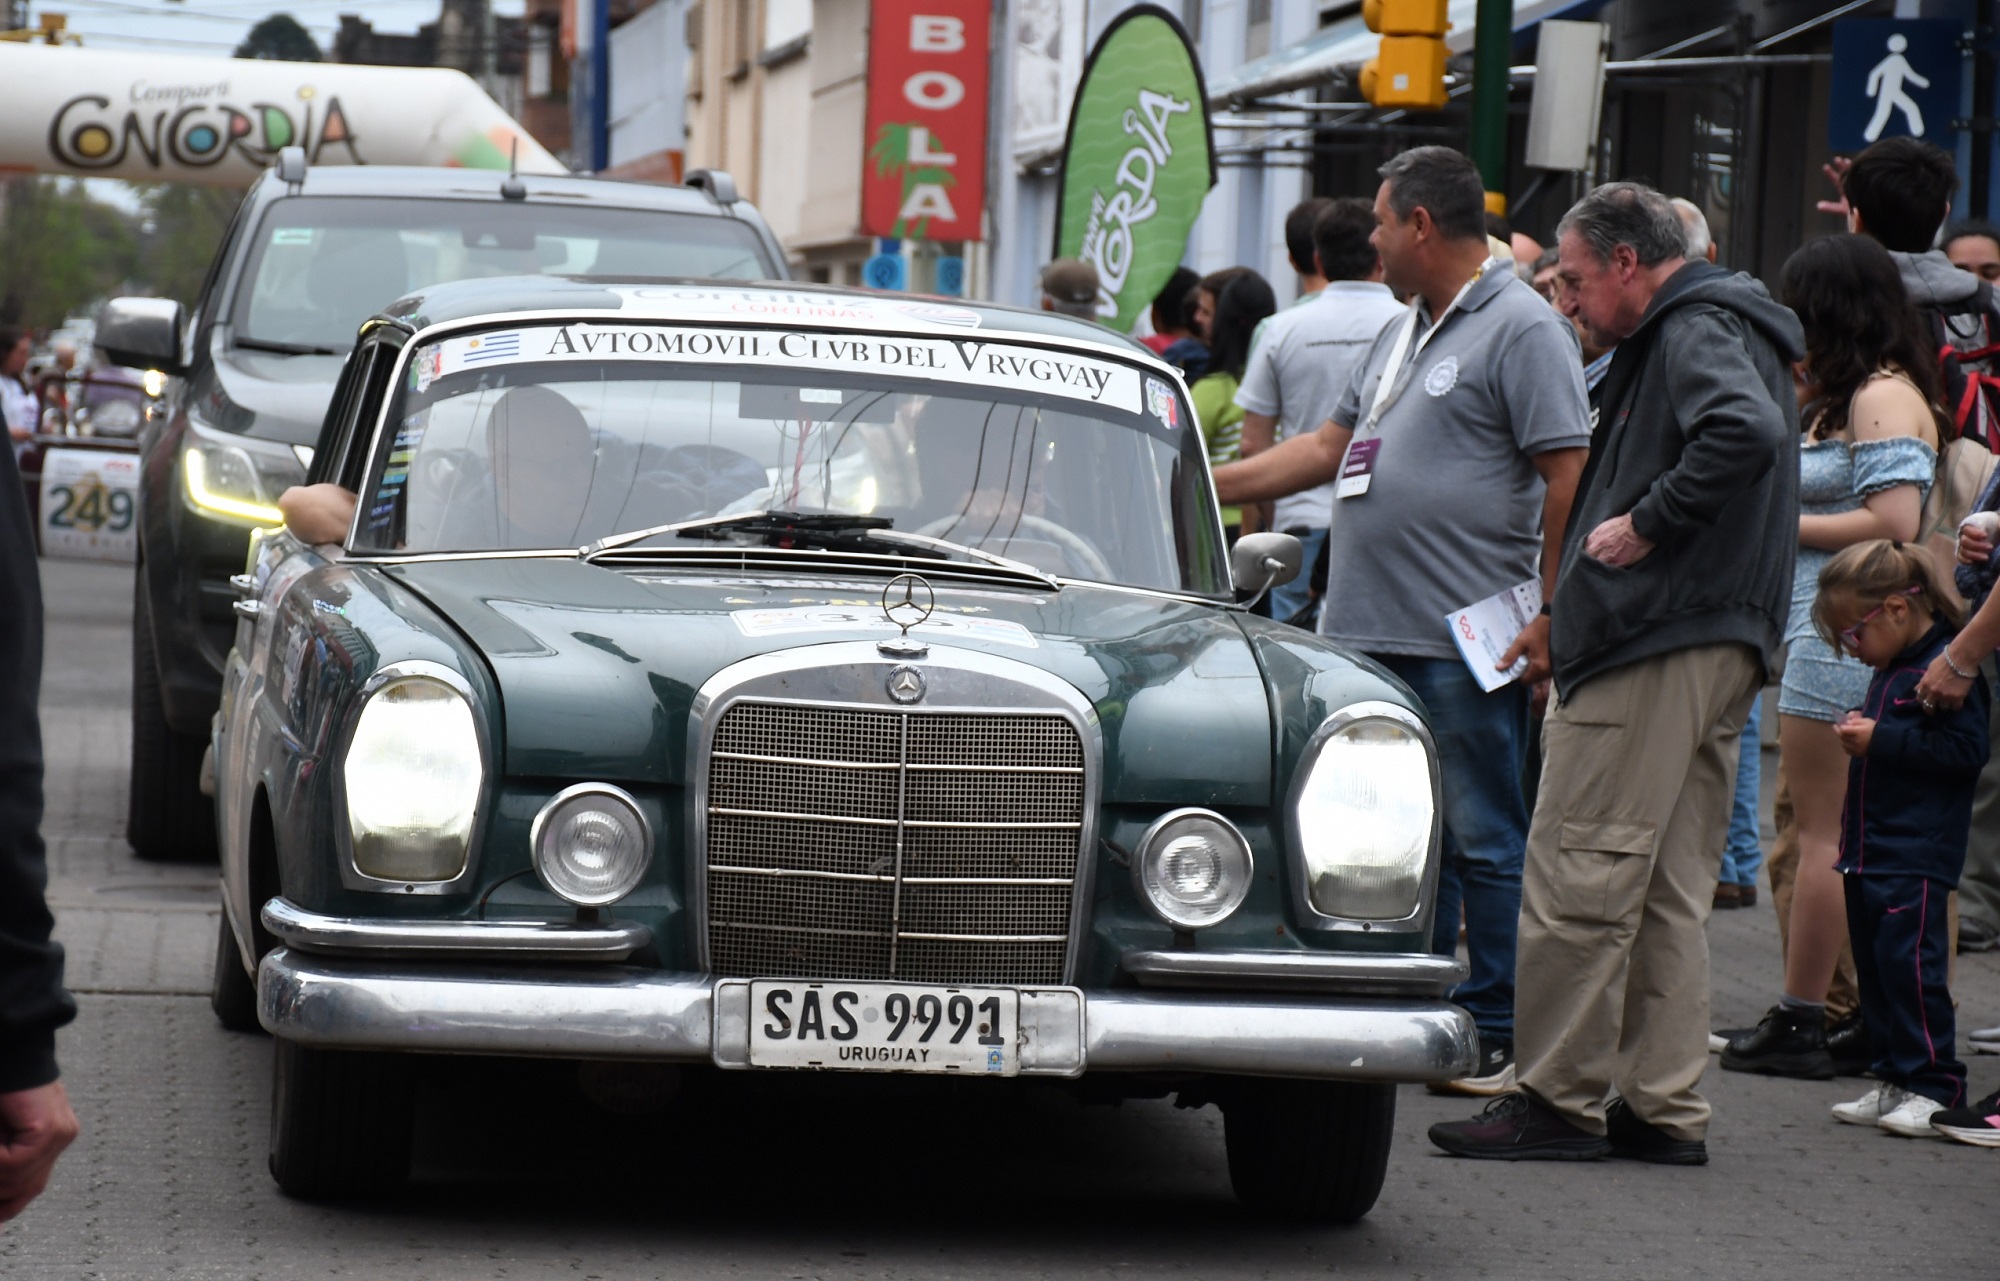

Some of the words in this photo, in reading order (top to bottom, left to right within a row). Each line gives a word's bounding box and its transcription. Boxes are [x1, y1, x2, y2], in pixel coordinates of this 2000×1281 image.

[899, 14, 965, 222] BOLA
[731, 303, 875, 320] CORTINAS
[546, 325, 770, 356] AVTOMOVIL
[779, 333, 869, 361] CLVB
[877, 344, 946, 369] DEL
[48, 484, 133, 532] 249
[764, 988, 860, 1041] SAS
[885, 993, 1005, 1046] 9991
[838, 1046, 931, 1064] URUGUAY
